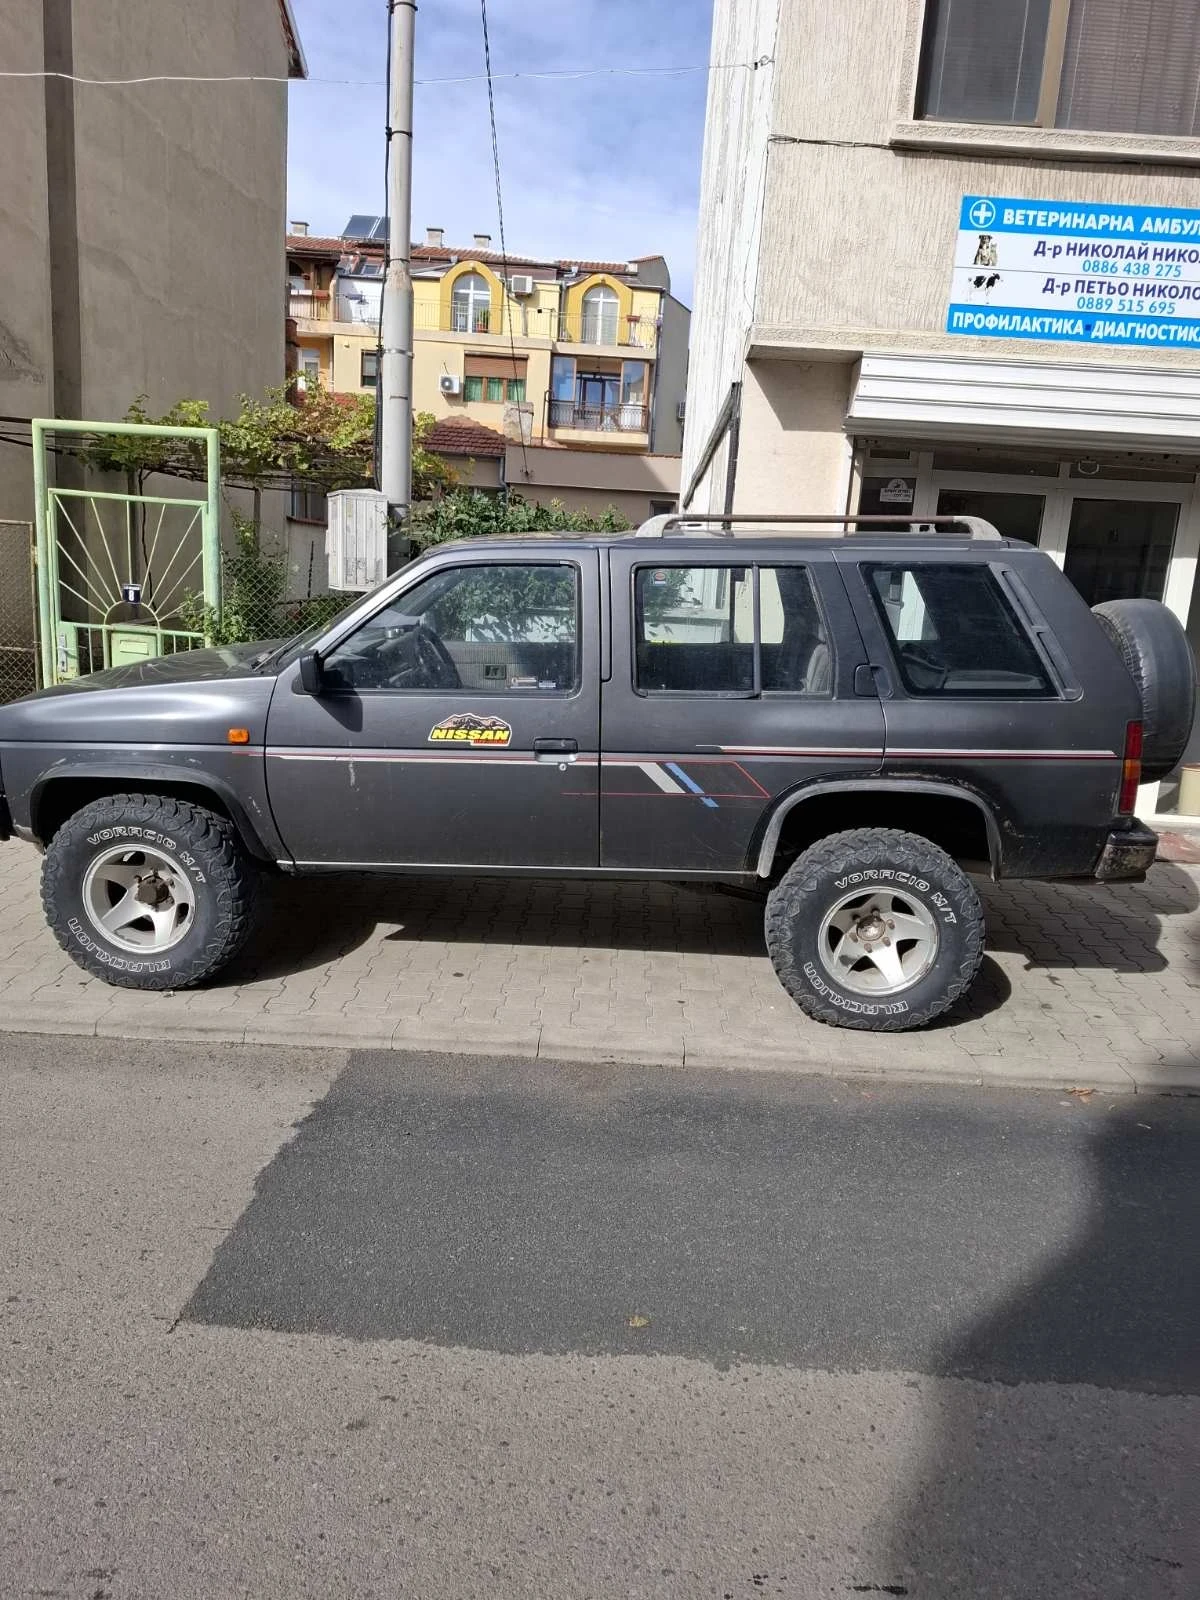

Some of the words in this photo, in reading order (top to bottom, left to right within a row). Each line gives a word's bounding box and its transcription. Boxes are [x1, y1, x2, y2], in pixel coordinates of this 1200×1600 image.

[1003, 208, 1134, 233] ВЕТЕРИНАРНА
[1034, 240, 1062, 257] Д-р
[1066, 242, 1149, 260] НИКОЛАЙ
[1152, 247, 1200, 263] НИКО
[1082, 260, 1118, 273] 0886
[1123, 262, 1150, 276] 438
[1155, 263, 1181, 277] 275
[1042, 278, 1071, 296] Д-р
[1074, 279, 1129, 296] ПЕТЬО
[1077, 297, 1113, 311] 0889
[1118, 299, 1144, 312] 515
[1149, 300, 1176, 314] 695
[953, 311, 1084, 336] ПРОФИЛАКТИКА
[1091, 319, 1200, 342] ДИАГНОСТИК
[431, 729, 510, 740] NISSAN
[87, 826, 177, 850] VORACIO
[179, 851, 207, 884] M/T
[835, 869, 930, 892] VORACIO
[931, 892, 957, 924] M/T
[67, 917, 171, 973] BLACKLION
[803, 962, 909, 1015] BLACKLION
